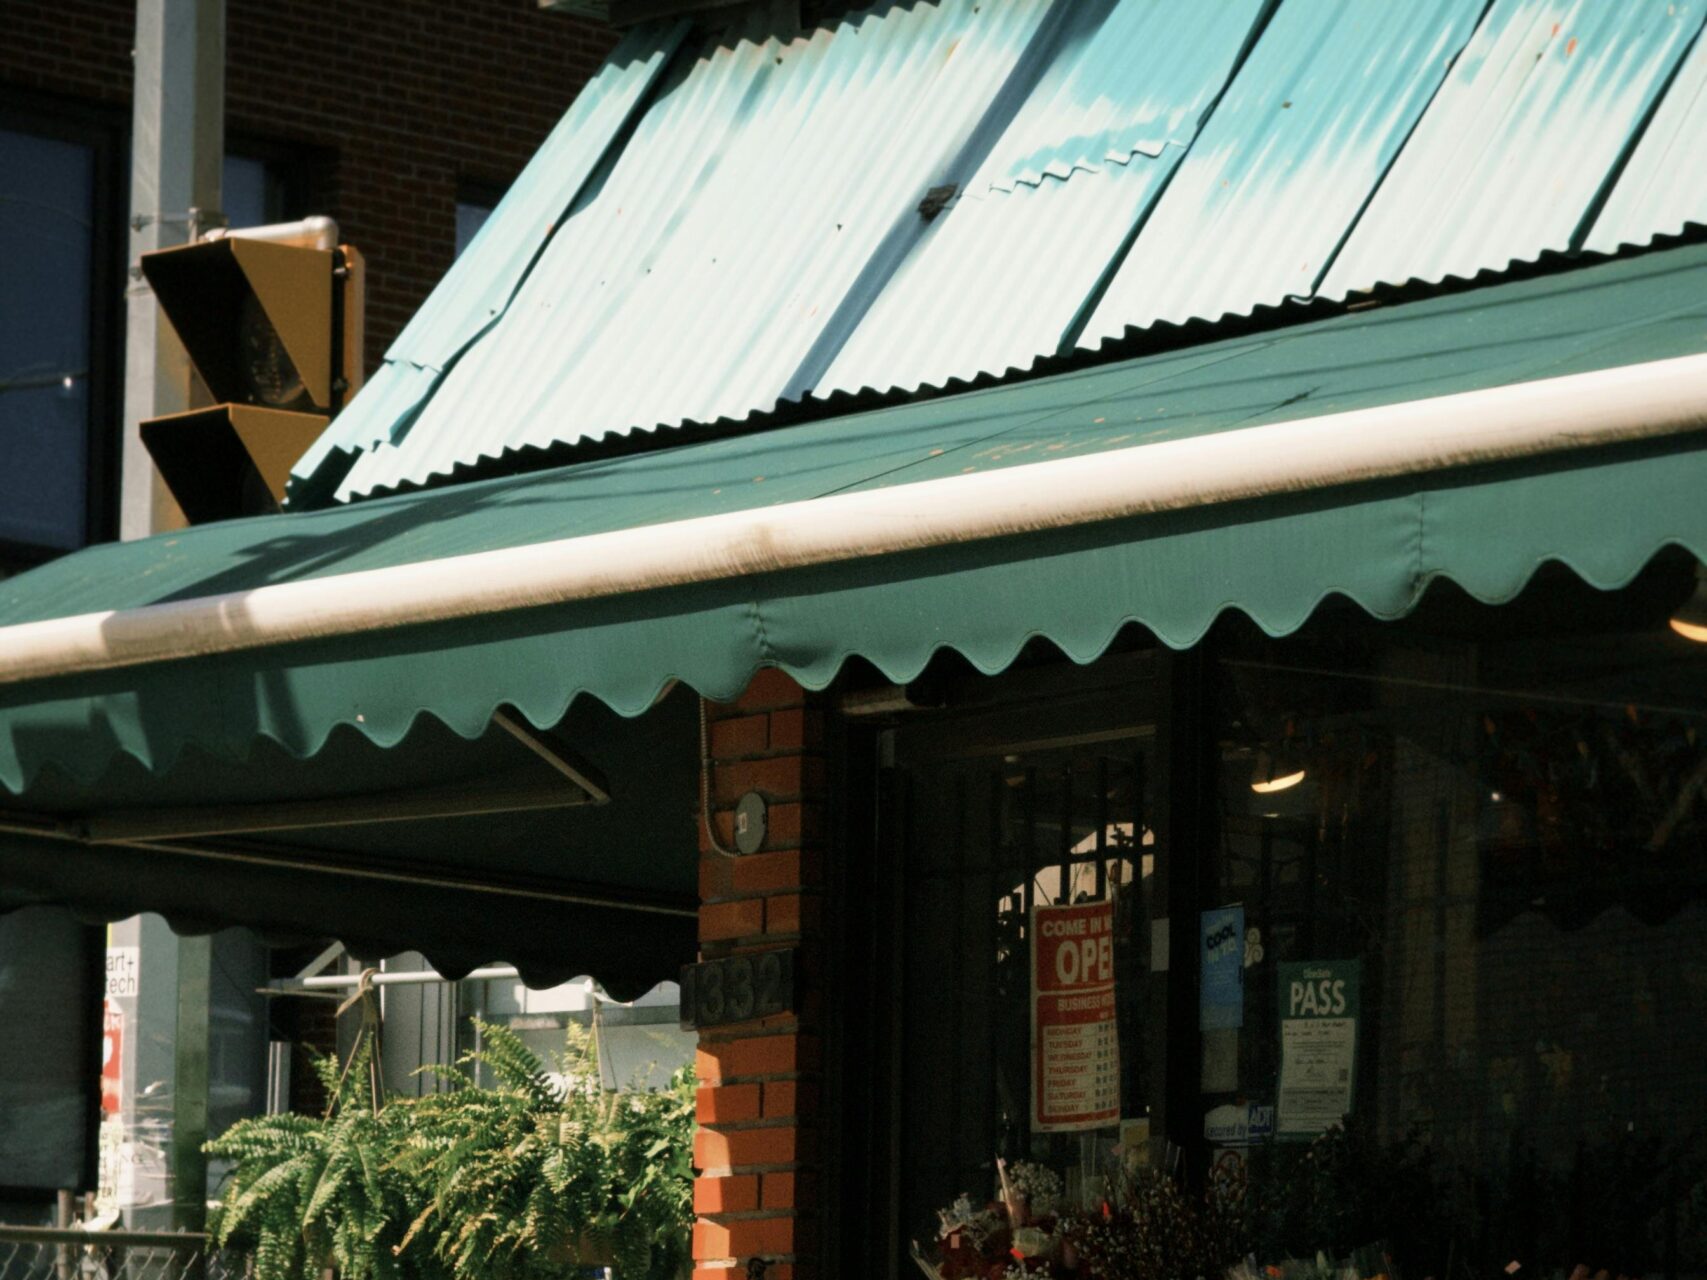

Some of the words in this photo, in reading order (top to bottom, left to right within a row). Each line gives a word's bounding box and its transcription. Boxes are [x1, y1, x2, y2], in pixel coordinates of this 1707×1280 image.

[1042, 918, 1087, 937] COME
[1090, 916, 1102, 934] IN
[1206, 923, 1237, 949] COOL
[1056, 936, 1113, 984] OPE
[1057, 996, 1101, 1012] BUSINESS
[1290, 980, 1345, 1016] PASS
[1047, 1027, 1082, 1036] MONDAY
[1049, 1040, 1083, 1049] TUESDAY
[1048, 1052, 1092, 1061] WEDNESDAY
[1048, 1065, 1088, 1074] THURSDAY
[1047, 1079, 1076, 1088] FRIDAY
[1047, 1091, 1086, 1101] SATURDAY
[1048, 1104, 1080, 1113] SUNDAY
[1249, 1105, 1272, 1124] ADT
[1207, 1123, 1235, 1137] secured
[1237, 1123, 1247, 1138] by
